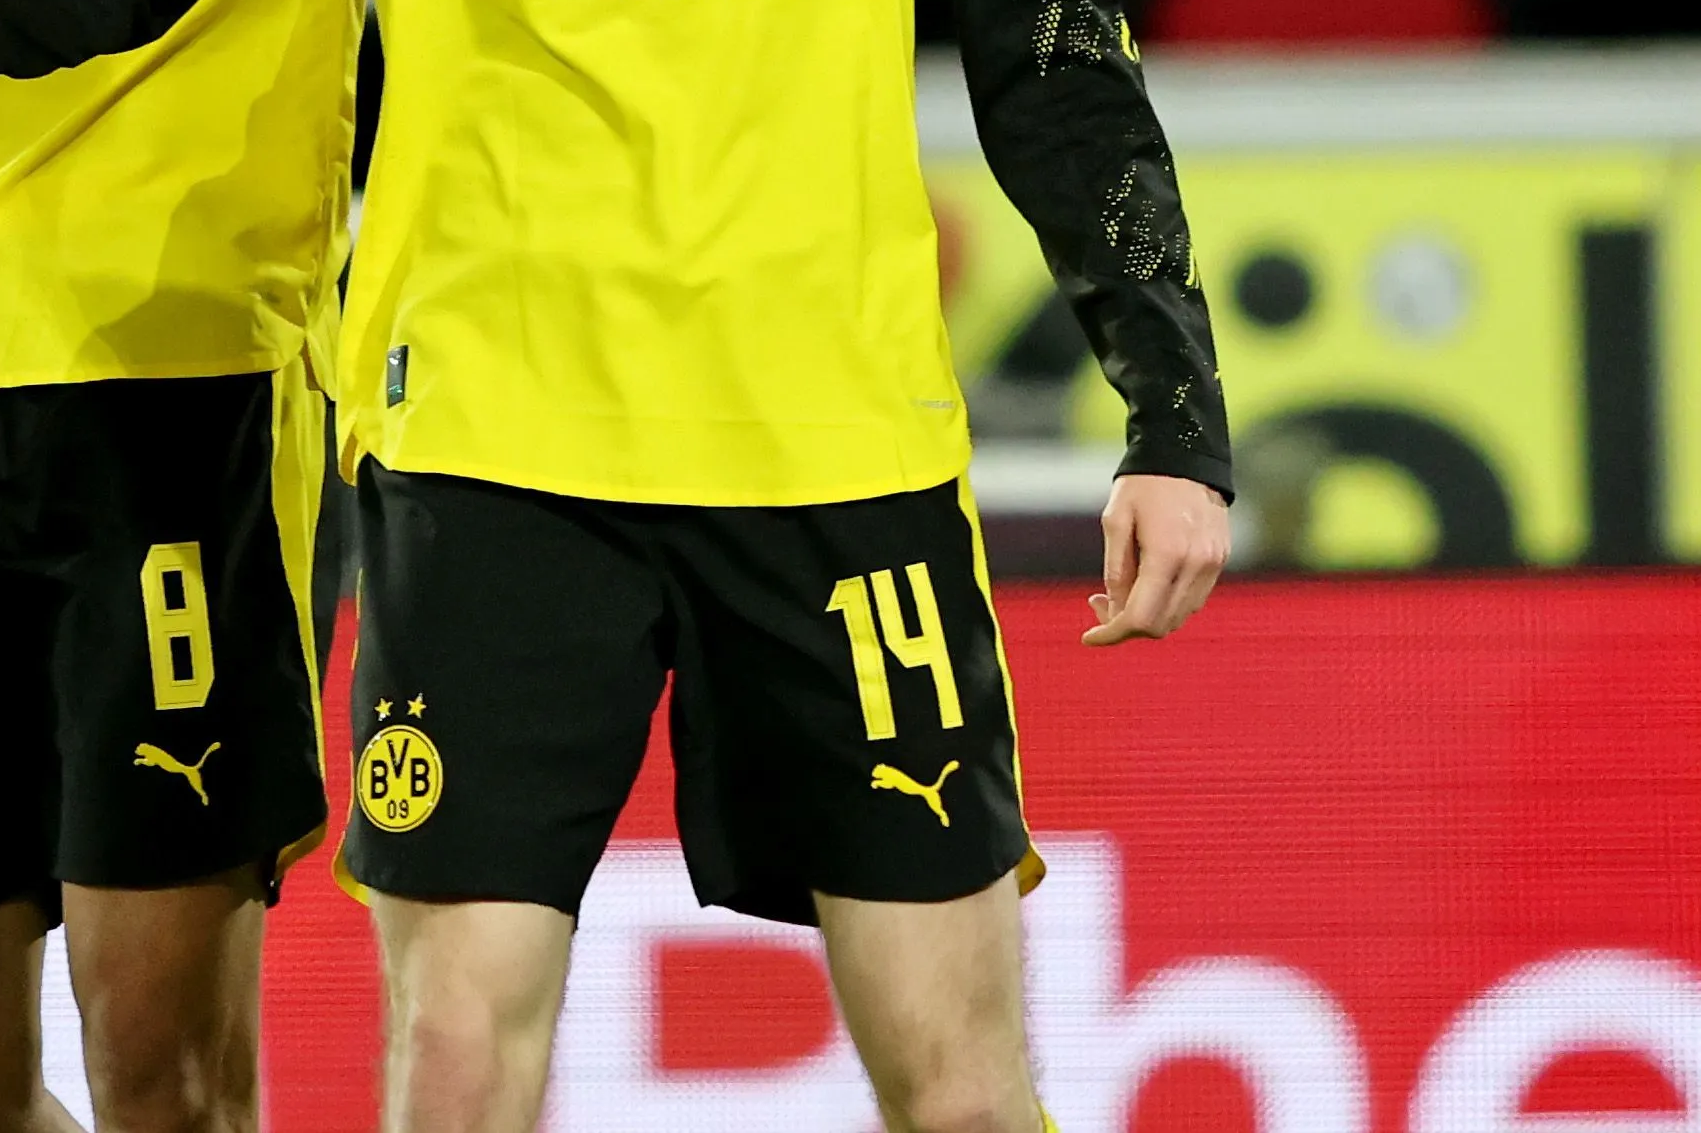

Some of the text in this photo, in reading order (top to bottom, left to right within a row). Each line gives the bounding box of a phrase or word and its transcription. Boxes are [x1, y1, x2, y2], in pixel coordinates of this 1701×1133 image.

[141, 541, 214, 710] 8
[825, 562, 963, 740] 14
[370, 738, 430, 799] BVB
[387, 798, 409, 819] 09
